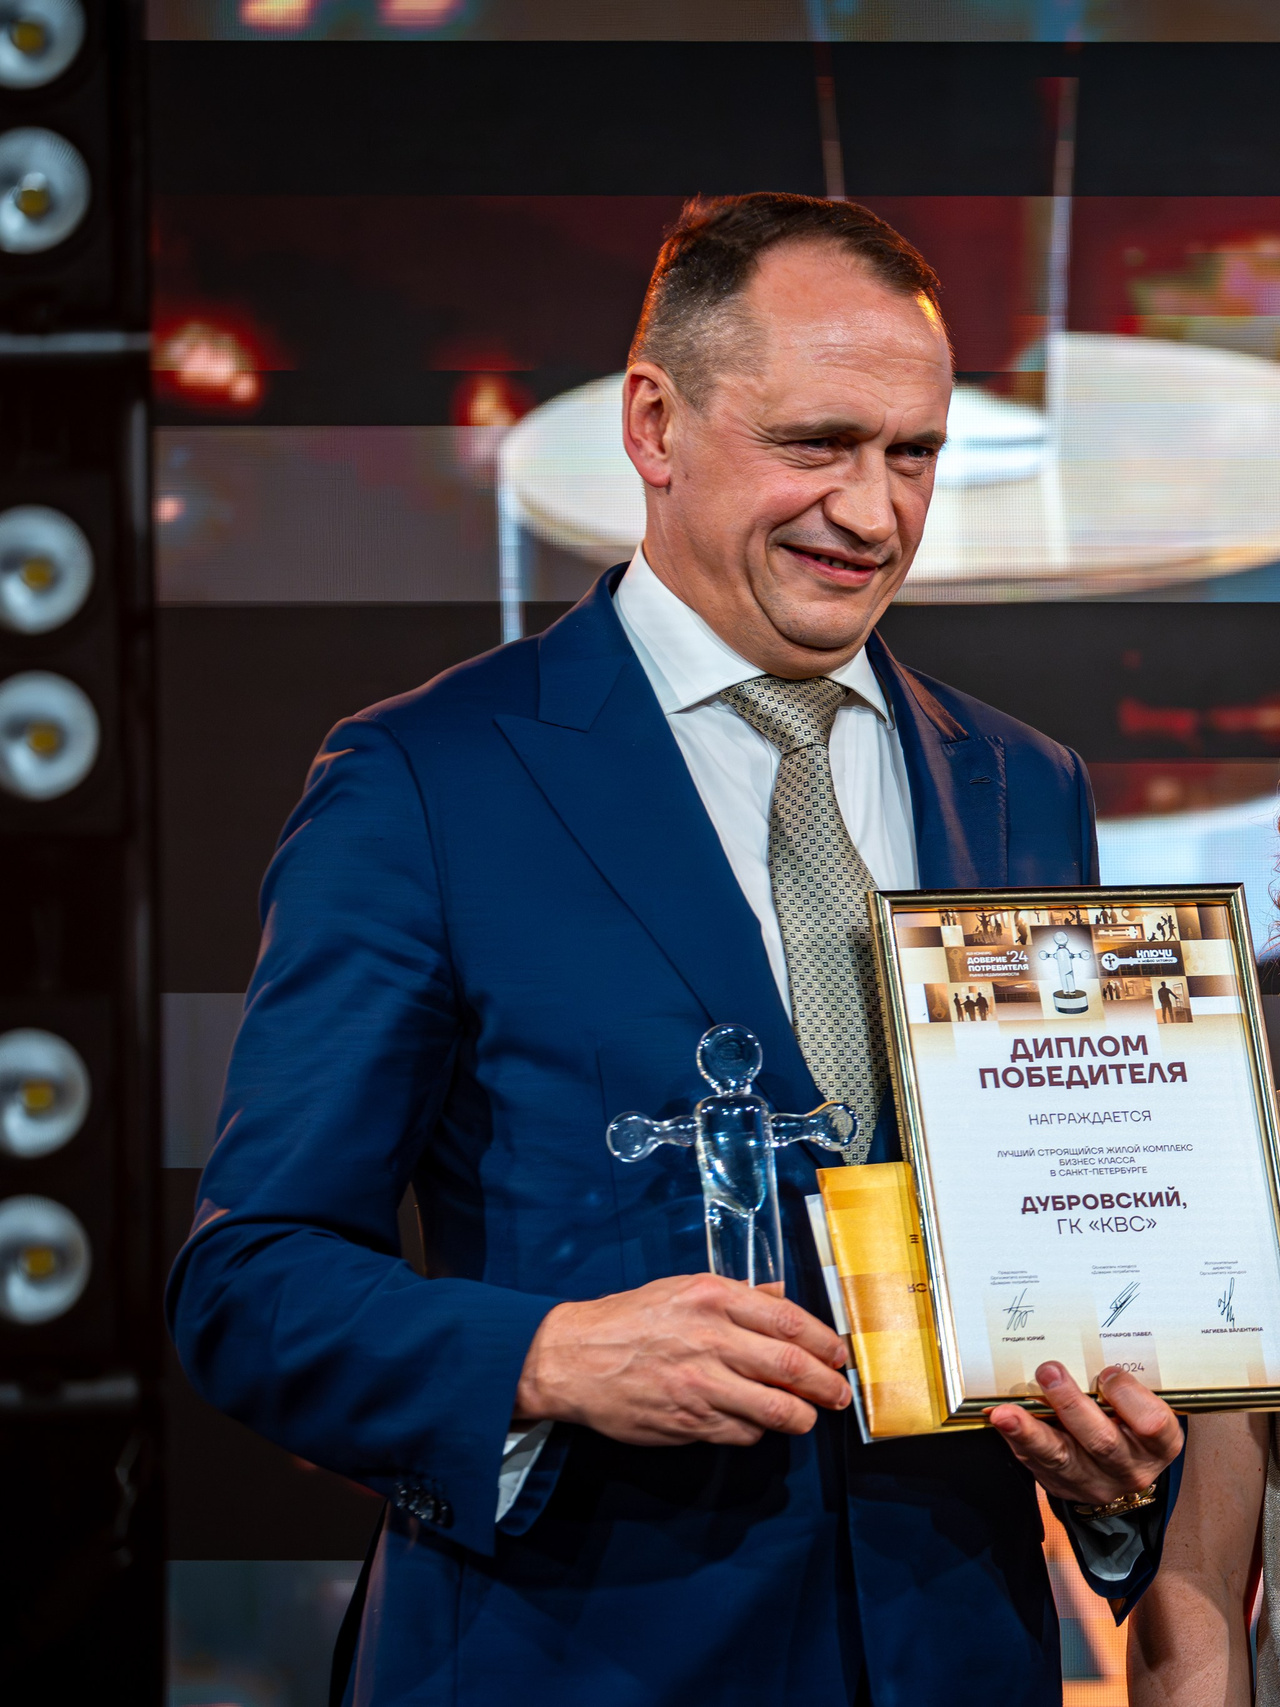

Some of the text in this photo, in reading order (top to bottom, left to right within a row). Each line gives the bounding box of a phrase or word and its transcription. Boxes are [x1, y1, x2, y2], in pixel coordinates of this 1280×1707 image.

[966, 956, 1008, 965] ДОВЕРИЕ
[968, 963, 1030, 972] ПОТРЕБИТЕЛЯ
[1009, 1034, 1149, 1063] ДИПЛОМ
[978, 1061, 1188, 1090] ПОБЕДИТЕЛЯ
[1028, 1110, 1152, 1126] НАГРАЖДАЕТСЯ
[996, 1143, 1194, 1158] ЛУЧШИЙ СТРОЯЩИЙСЯ ЖИЛОЙ КОМПЛЕКС
[1058, 1156, 1136, 1166] БИЗНЕС КЛАССА
[1050, 1166, 1148, 1177] В САНКТ-ПЕТЕРБУРГЕ
[1021, 1186, 1188, 1215] ДУБРОВСКИЙ,
[1057, 1215, 1157, 1235] ГК «КВС»
